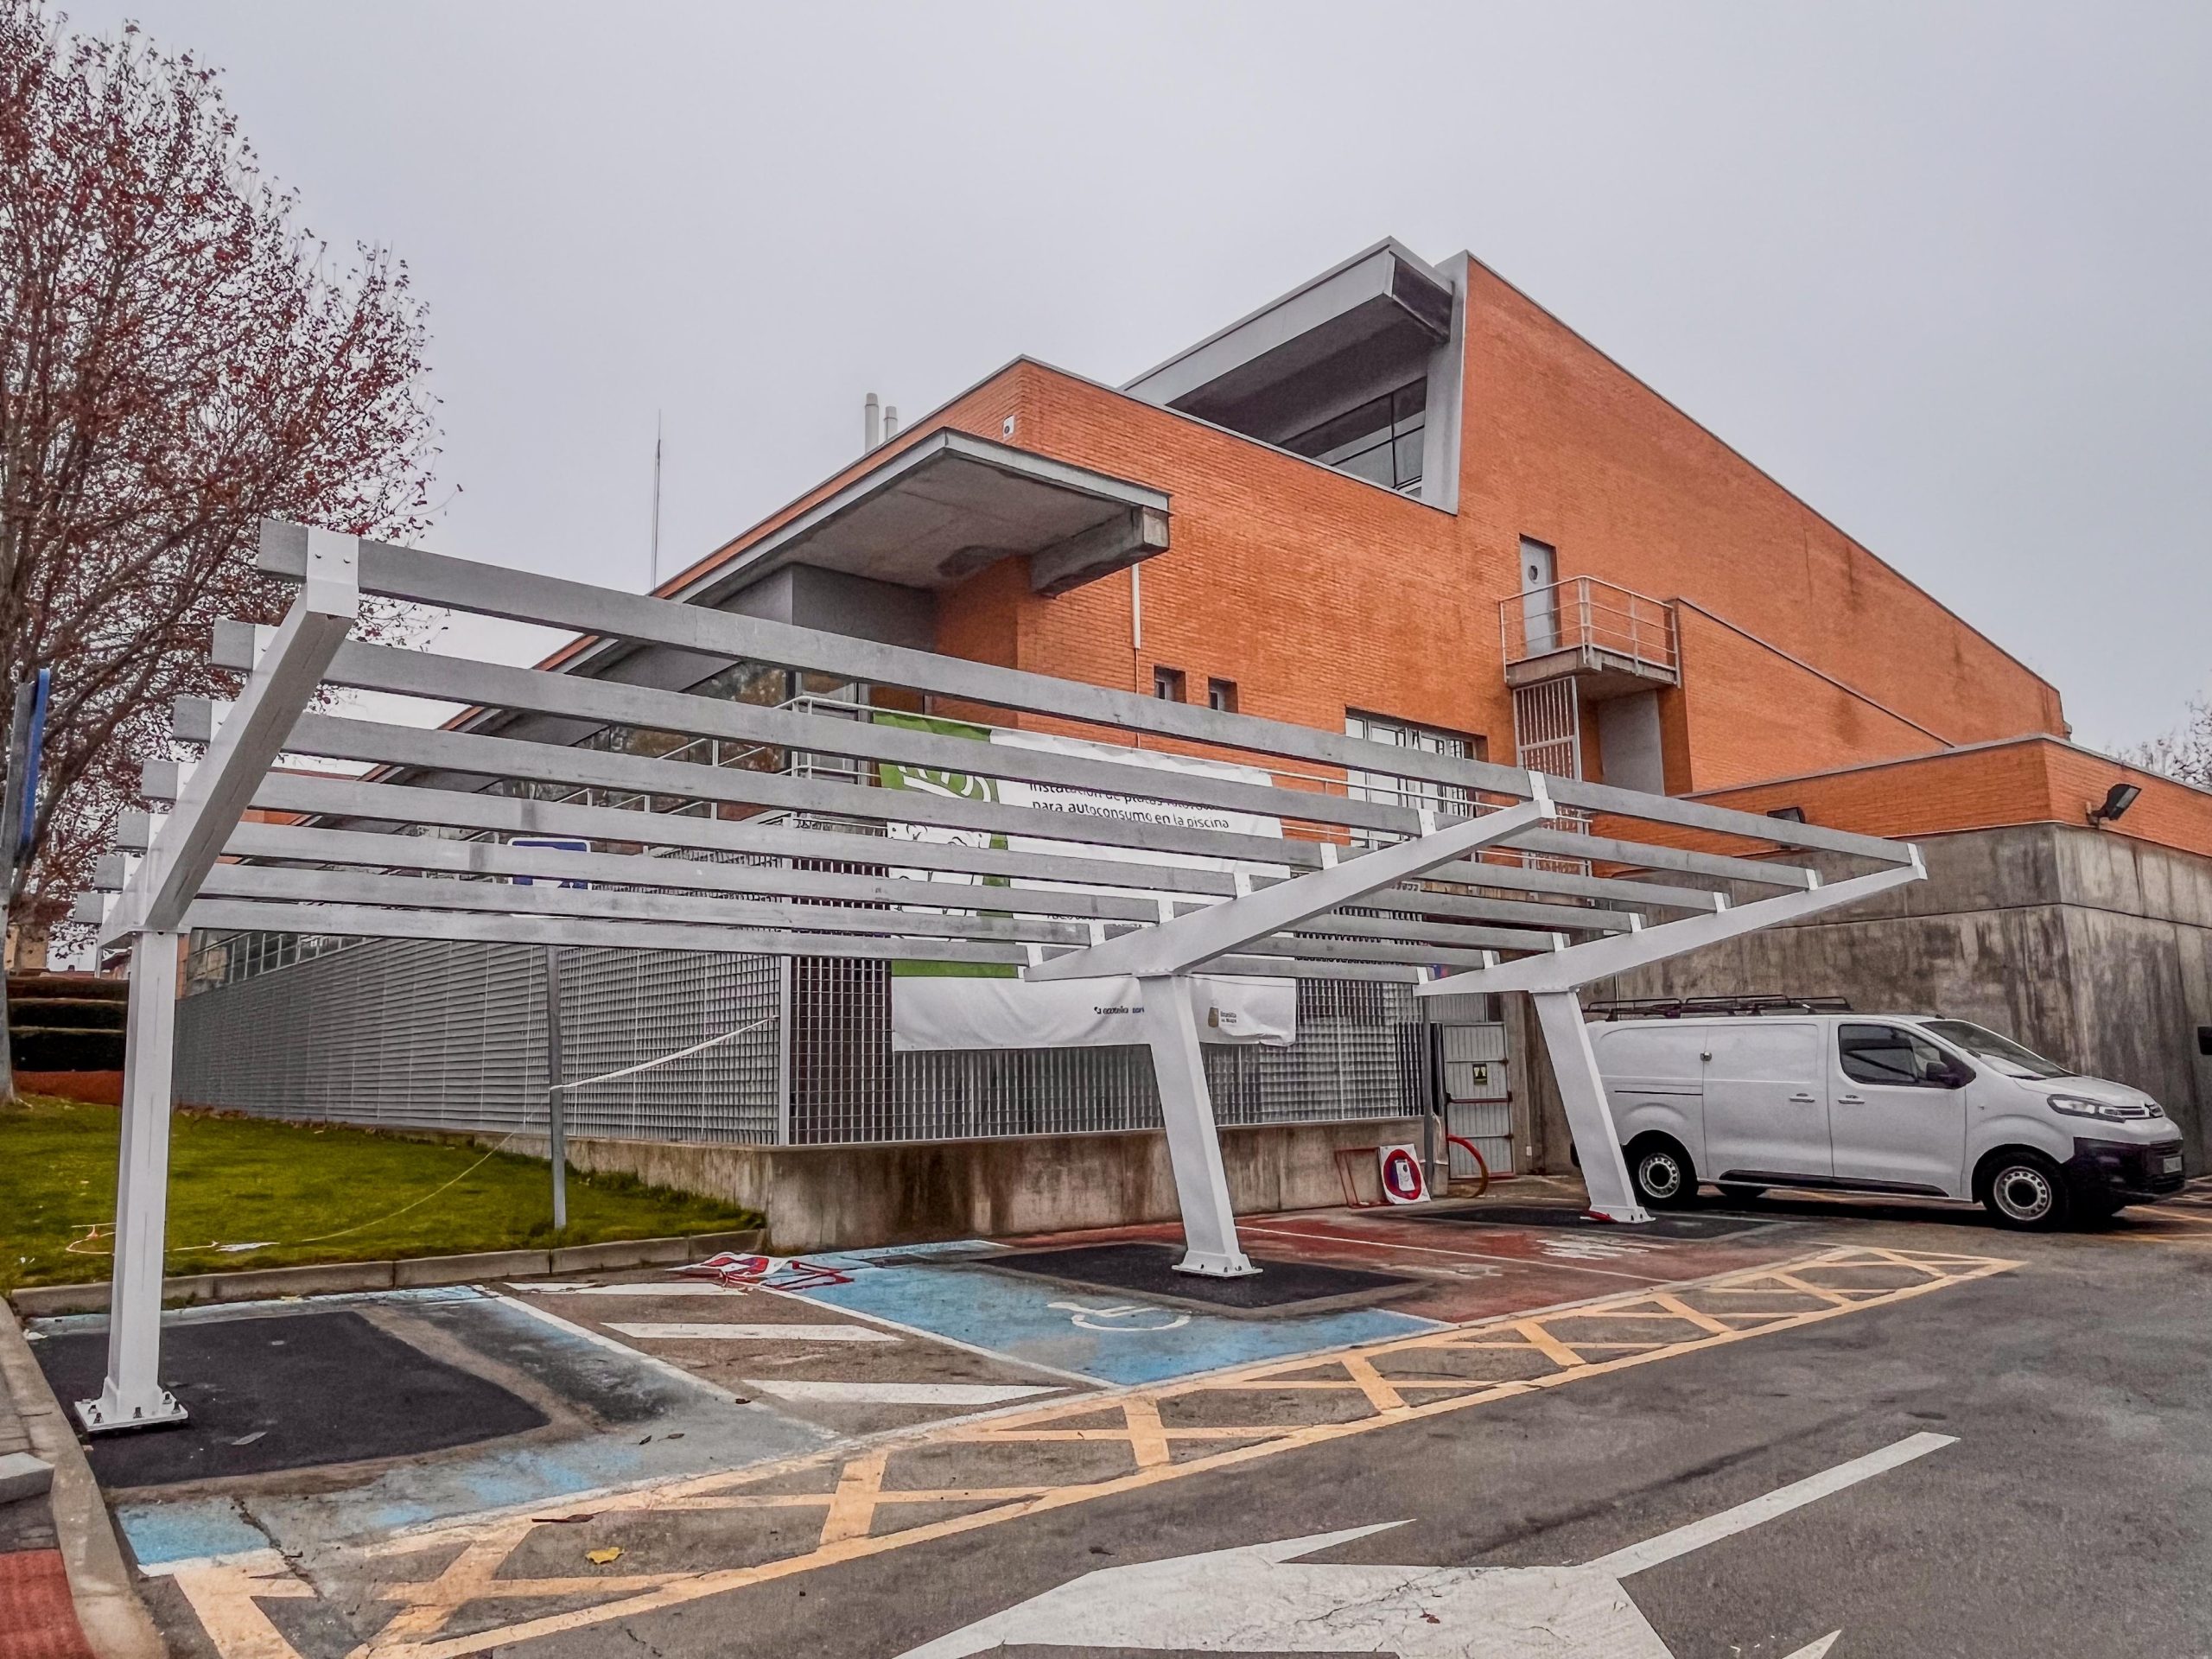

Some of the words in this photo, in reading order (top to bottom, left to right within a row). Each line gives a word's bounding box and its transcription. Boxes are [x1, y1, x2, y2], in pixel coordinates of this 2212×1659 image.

[1068, 803, 1153, 823] autoconsumo
[1154, 814, 1171, 824] en
[1173, 812, 1184, 826] la
[1186, 816, 1230, 829] piscina
